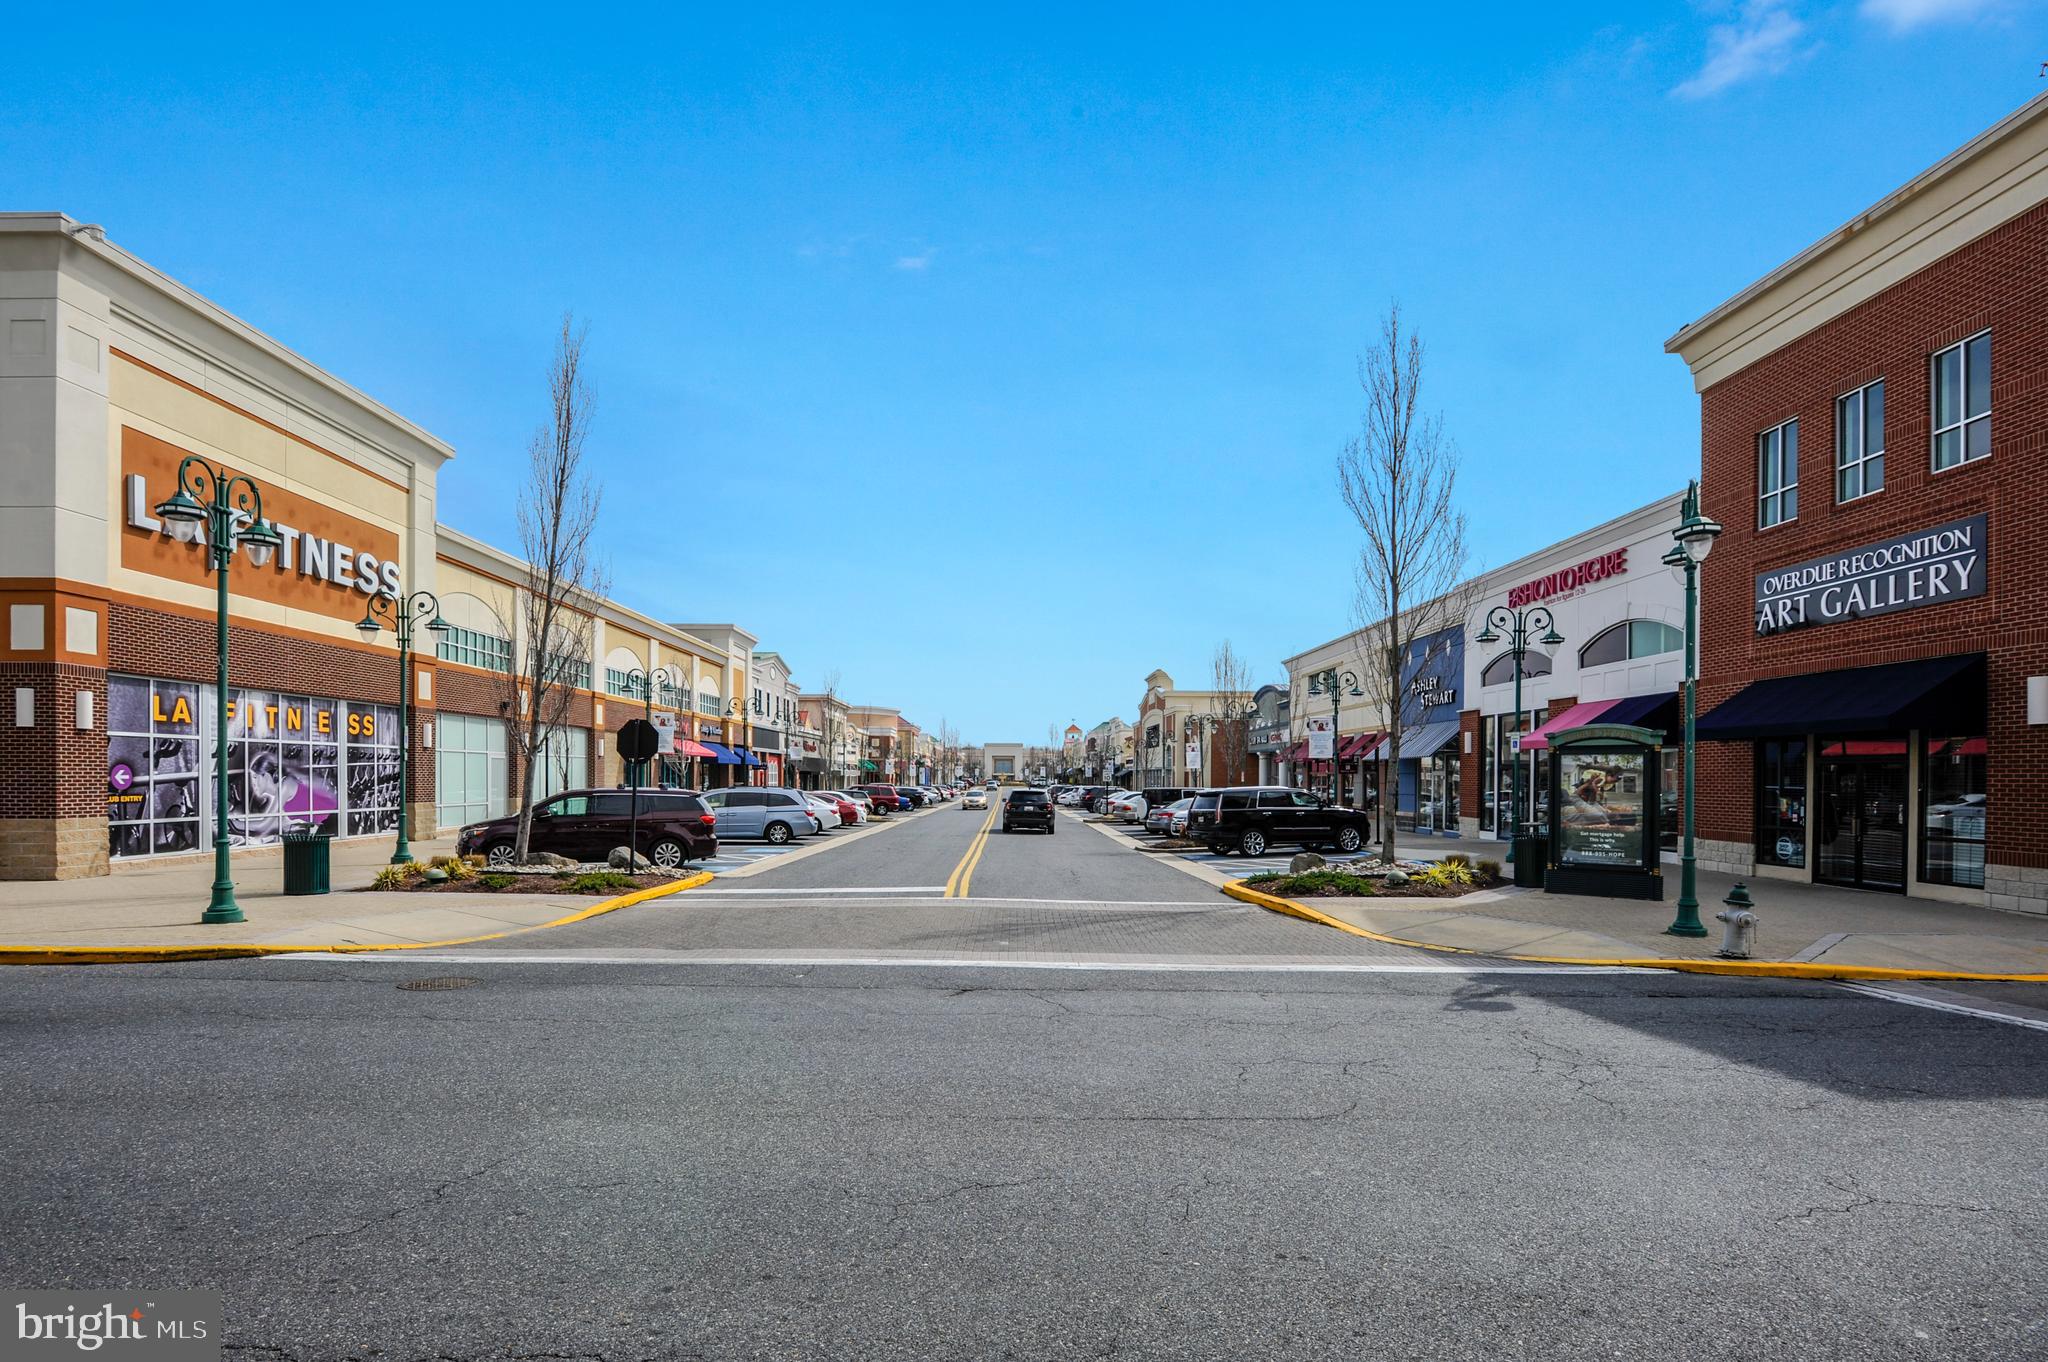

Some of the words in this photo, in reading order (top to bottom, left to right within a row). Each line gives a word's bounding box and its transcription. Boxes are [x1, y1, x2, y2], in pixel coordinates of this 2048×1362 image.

[208, 501, 400, 600] FTNESS
[1763, 562, 1836, 595] OVERDUE
[1839, 526, 1973, 577] RECOGNITION
[1508, 575, 1557, 609] FASHION
[1556, 566, 1578, 593] TO
[1577, 547, 1628, 587] FIGURE
[1757, 594, 1812, 632] ART
[1820, 555, 1978, 618] GALLERY
[1410, 676, 1439, 696] ASHLEY
[1420, 689, 1456, 710] STEWART
[153, 695, 192, 724] LA
[120, 795, 144, 803] ENTRY
